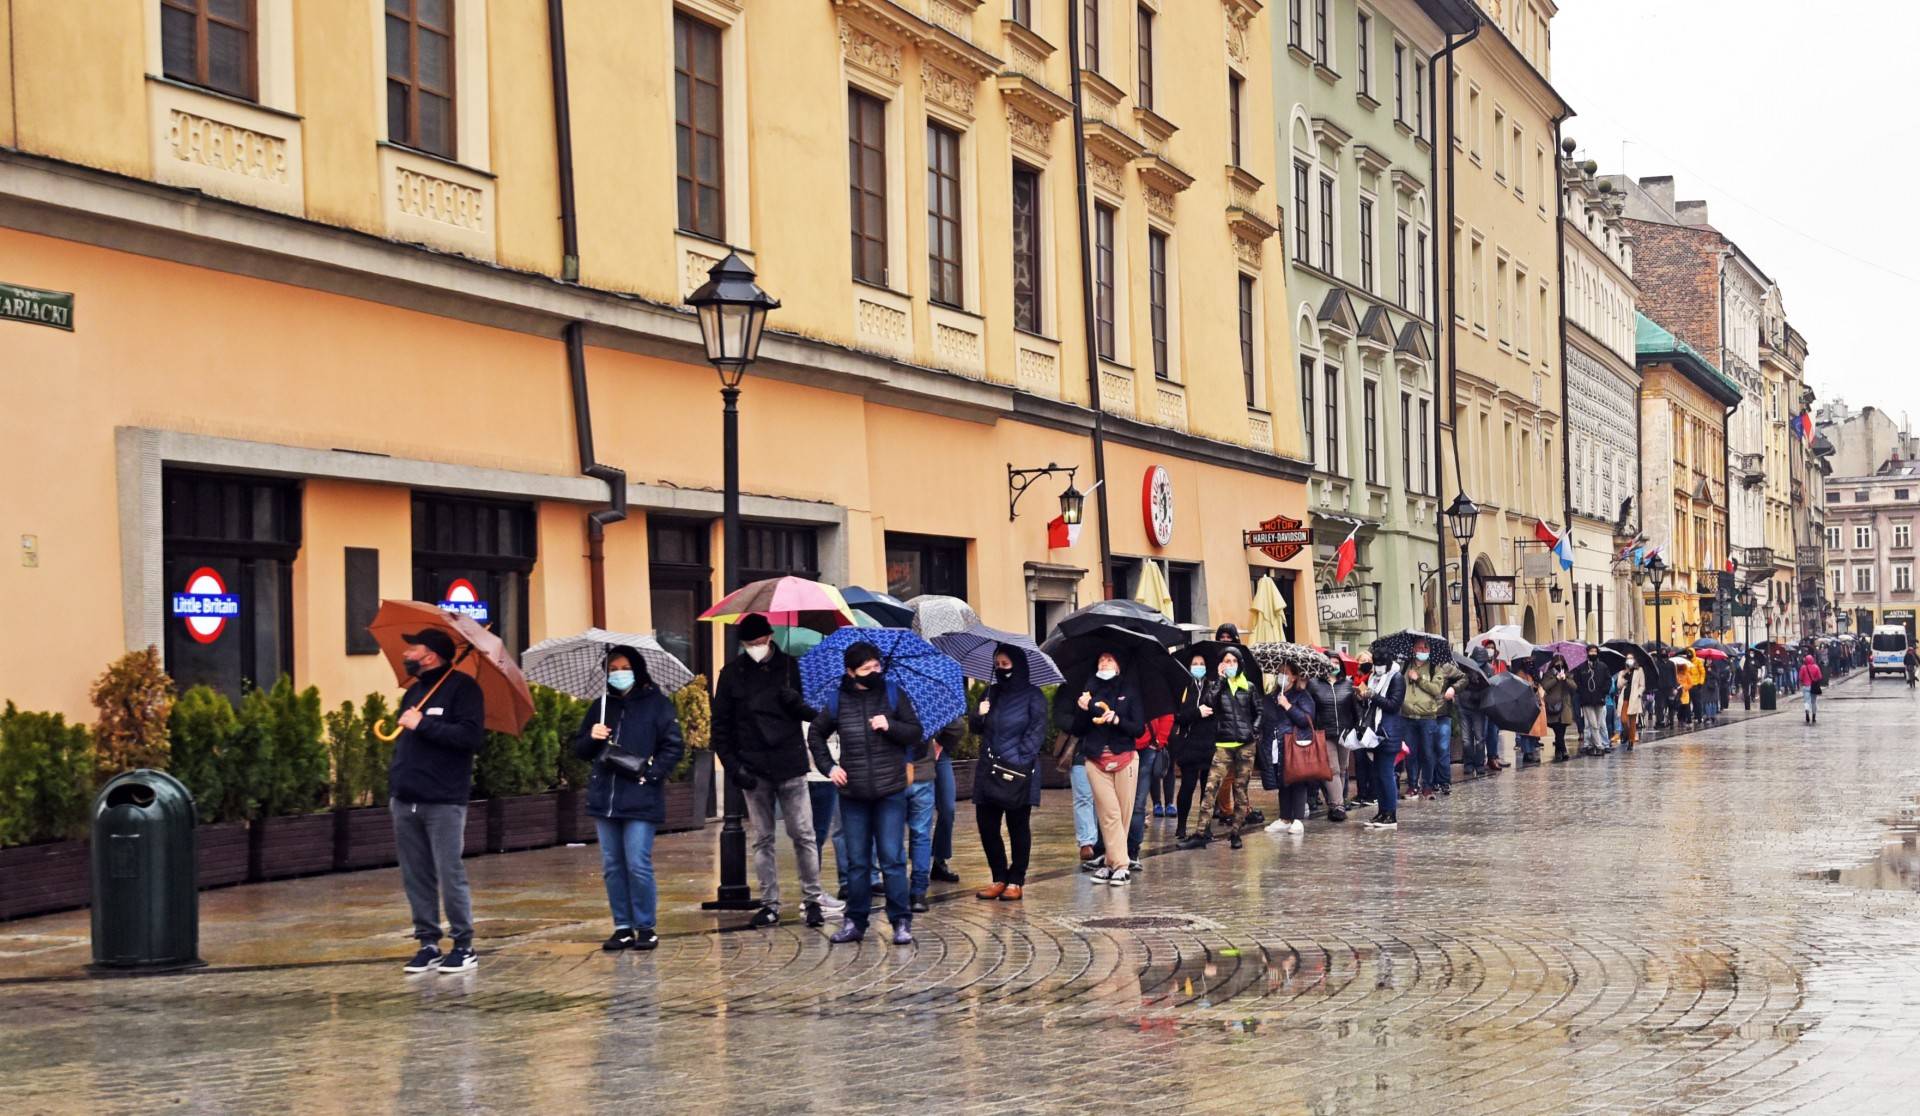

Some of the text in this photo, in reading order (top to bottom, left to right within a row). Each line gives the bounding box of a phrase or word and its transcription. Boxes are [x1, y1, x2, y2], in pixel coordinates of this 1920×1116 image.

[0, 296, 68, 325] ARIACKI
[1264, 519, 1294, 530] MOTOR
[1252, 531, 1307, 543] HARLEY-DAVIDSON
[1265, 544, 1295, 558] CYCLES
[173, 596, 238, 614] Little Britain
[1318, 604, 1360, 621] Bianca
